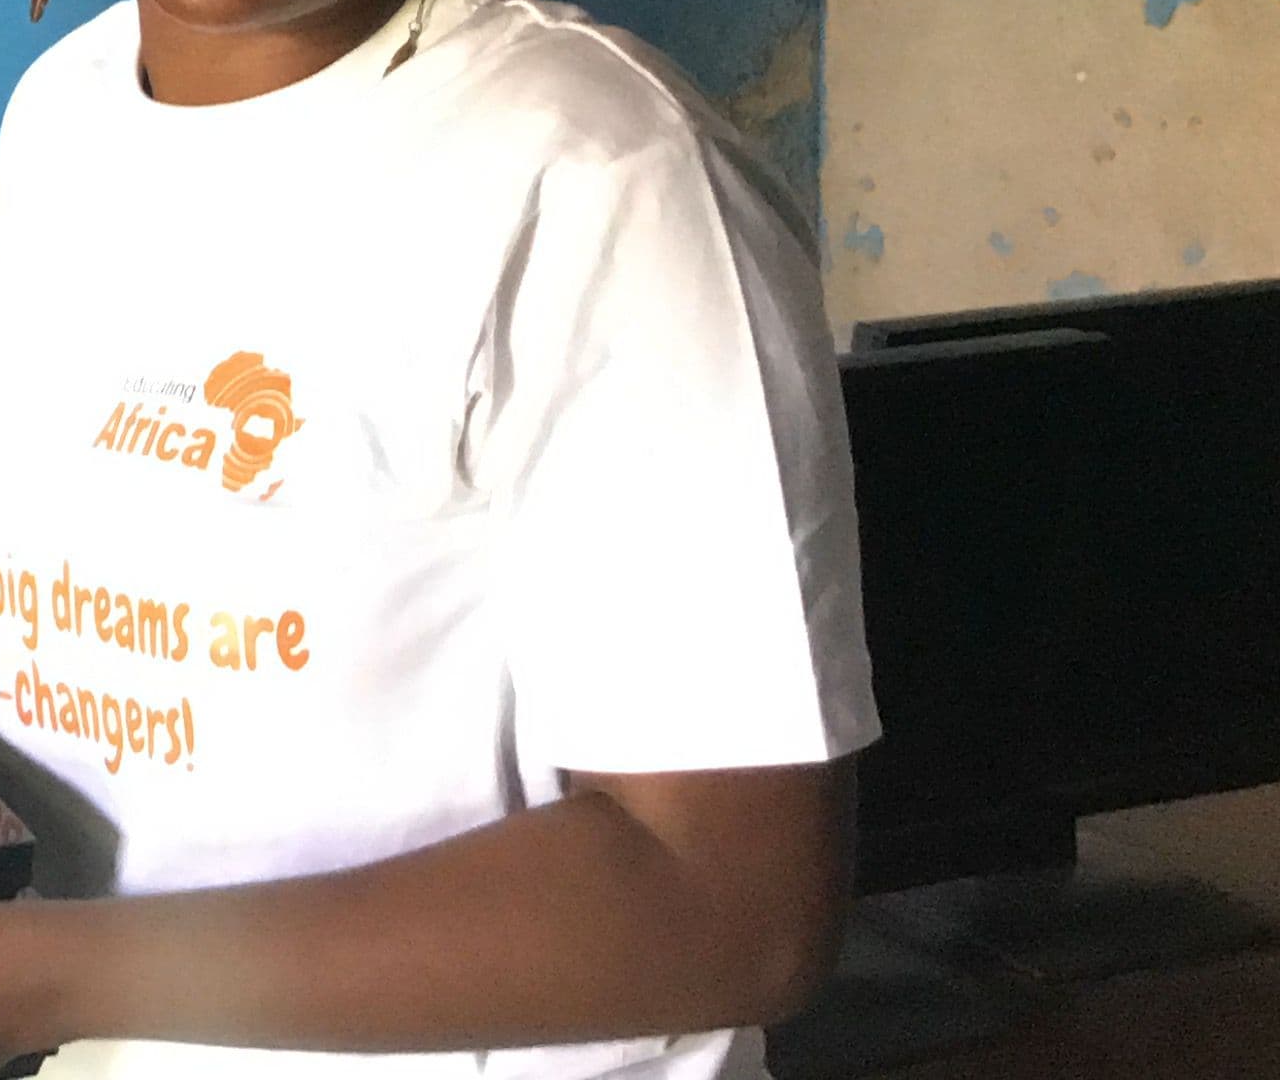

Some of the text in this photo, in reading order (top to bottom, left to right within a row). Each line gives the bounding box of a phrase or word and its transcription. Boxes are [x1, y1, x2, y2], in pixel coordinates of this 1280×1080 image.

[92, 401, 217, 470] Africa
[50, 559, 191, 663] dreams
[208, 609, 310, 672] are
